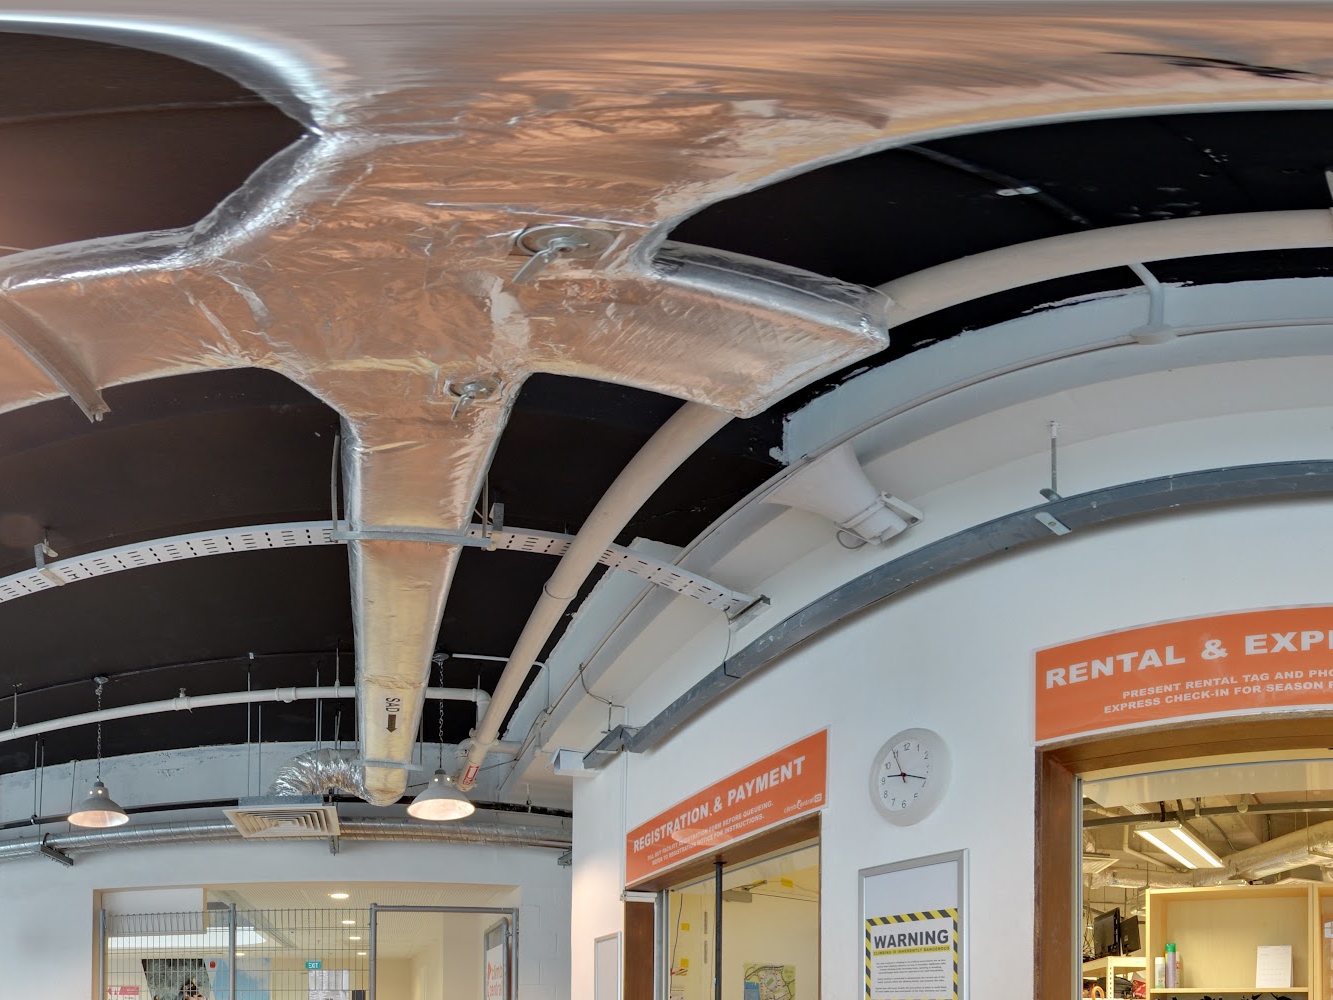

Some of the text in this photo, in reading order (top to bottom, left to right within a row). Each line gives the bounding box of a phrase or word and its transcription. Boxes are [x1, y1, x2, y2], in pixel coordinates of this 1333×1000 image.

[1046, 630, 1333, 689] RENTAL & EXP
[1123, 683, 1180, 699] PRESENT
[1186, 676, 1237, 689] RENTAL
[1242, 672, 1270, 682] TAG
[1274, 670, 1303, 680] AND
[386, 698, 400, 712] SAD
[1104, 681, 1323, 714] EXPRESS CHECK-IN FOR SEASON
[904, 743, 910, 751] 12
[882, 777, 885, 785] 9
[884, 790, 888, 798] 8
[892, 798, 895, 806] 7
[902, 800, 906, 808] 6
[634, 756, 805, 853] REGISTRATION & PAYMENT
[662, 843, 678, 854] FACILITY
[709, 823, 721, 832] FORM
[723, 813, 741, 825] BEFORE
[743, 801, 774, 816] QUEUEING.
[669, 843, 697, 858] REGISTRATION
[697, 835, 713, 845] NOTICE
[714, 830, 723, 838] FOR
[725, 814, 764, 833] INSTRUCTIONS.
[874, 929, 949, 949] WARNING
